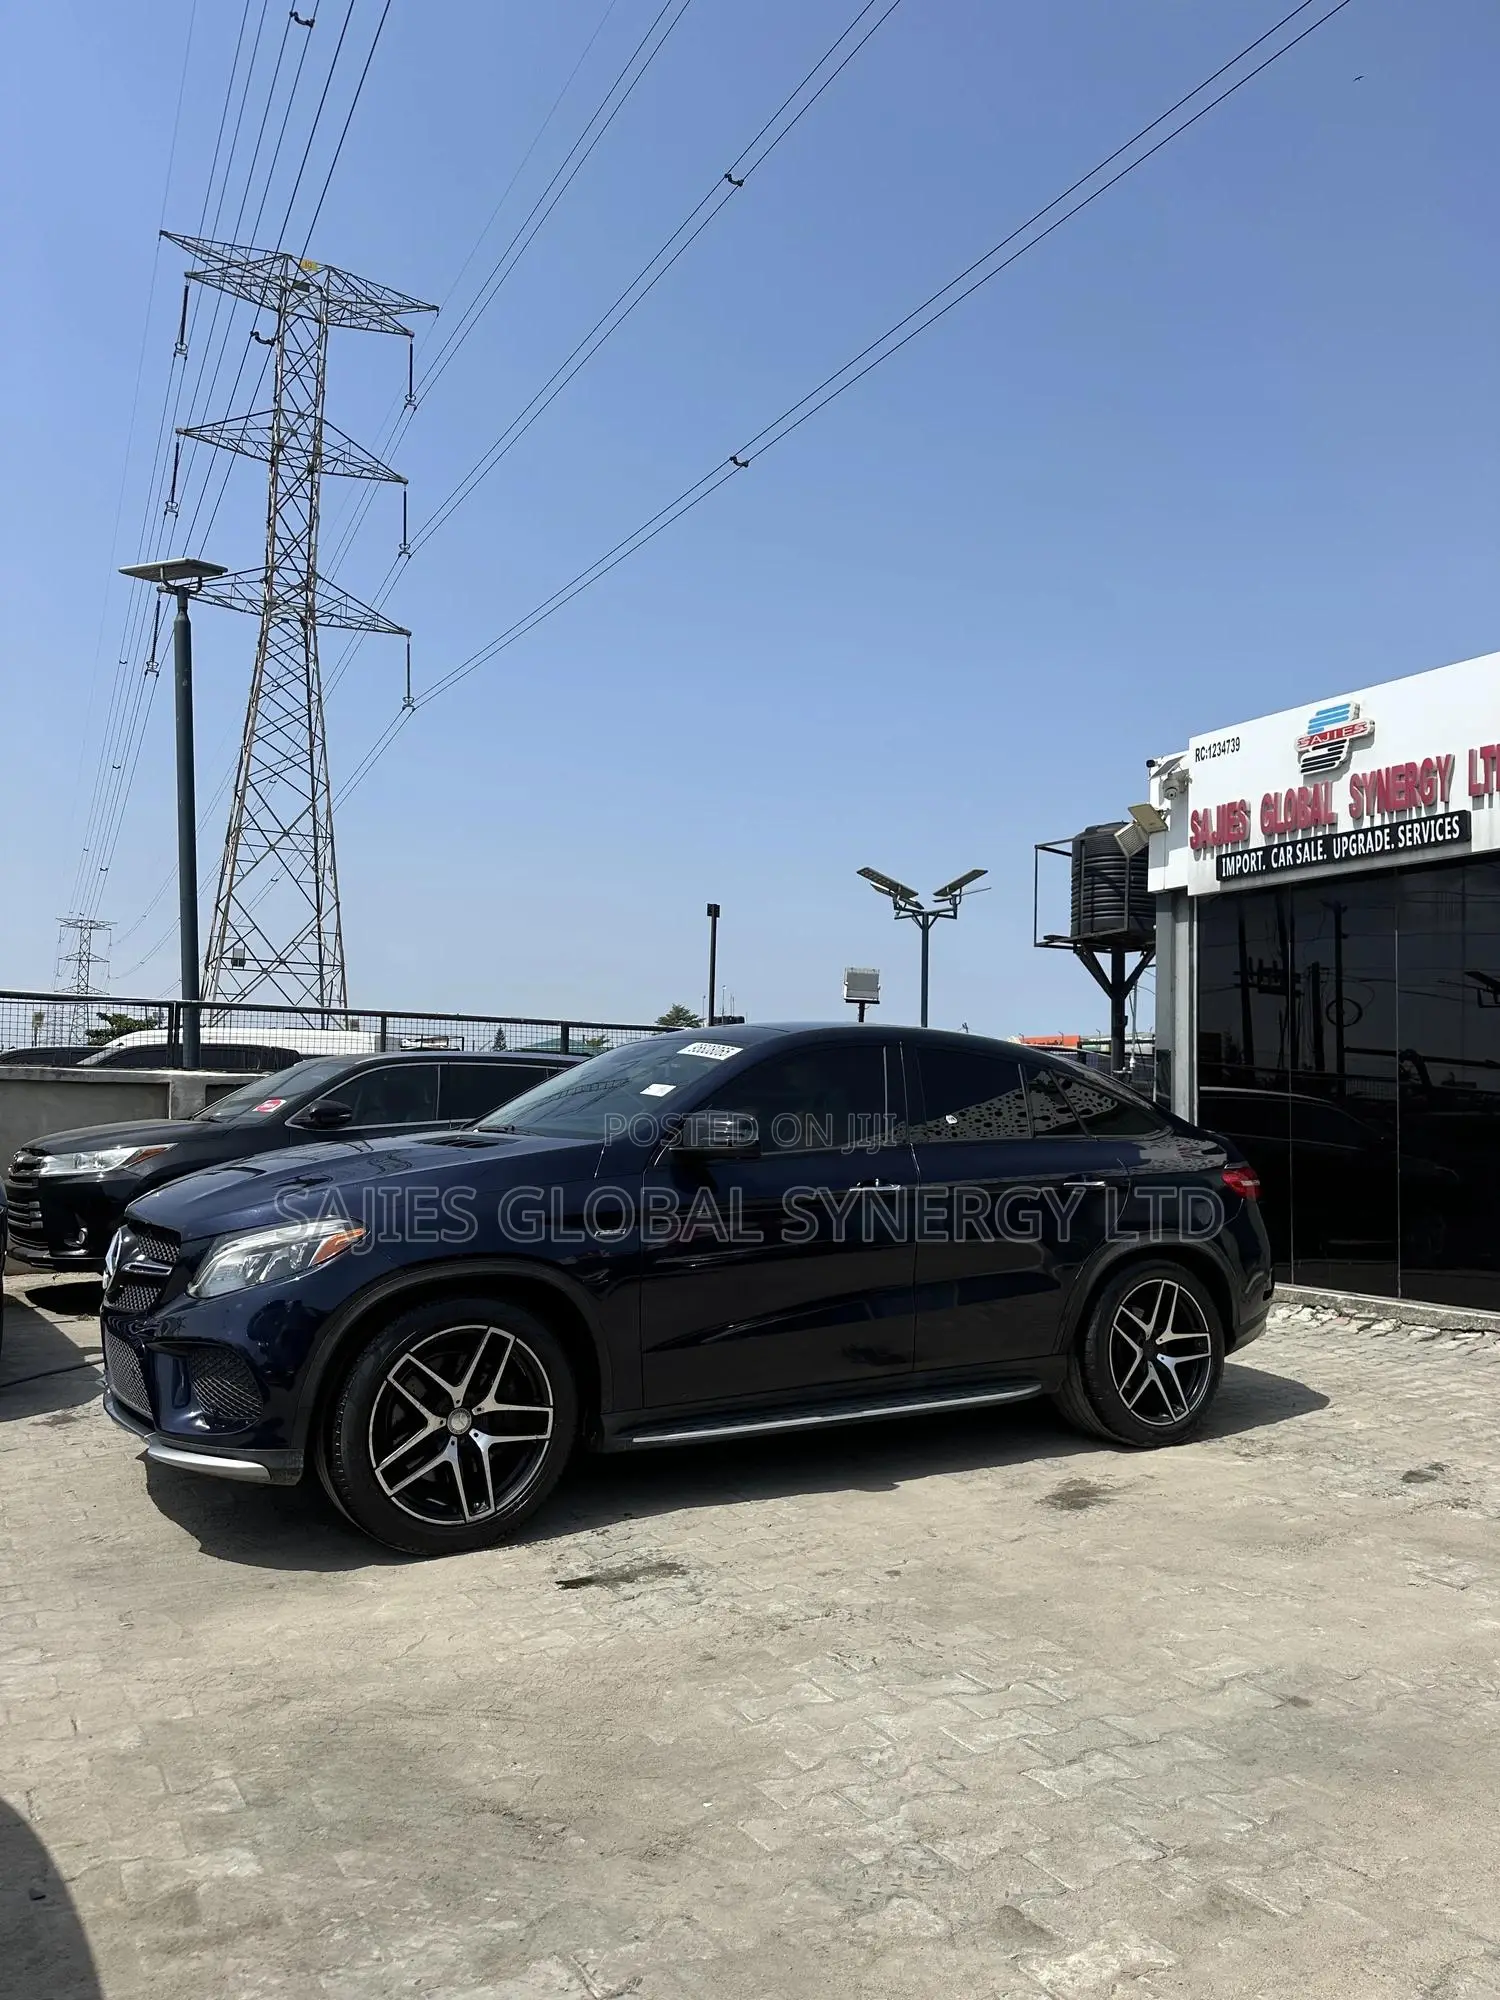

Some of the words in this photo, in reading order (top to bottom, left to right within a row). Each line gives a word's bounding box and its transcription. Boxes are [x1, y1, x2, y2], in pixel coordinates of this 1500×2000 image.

[1195, 737, 1241, 763] RC:1234739
[1298, 720, 1368, 748] SAJIES
[1190, 799, 1250, 850] SAJIES
[1261, 781, 1337, 835] GLOBAL
[1349, 754, 1455, 819] SYNERGY
[1468, 744, 1500, 796] LT
[1222, 851, 1266, 877] IMPORT.
[1271, 847, 1294, 869] CAR
[1296, 839, 1328, 865] SALE.
[1333, 828, 1395, 859] UPGRADE.
[1398, 815, 1460, 848] SERVICES
